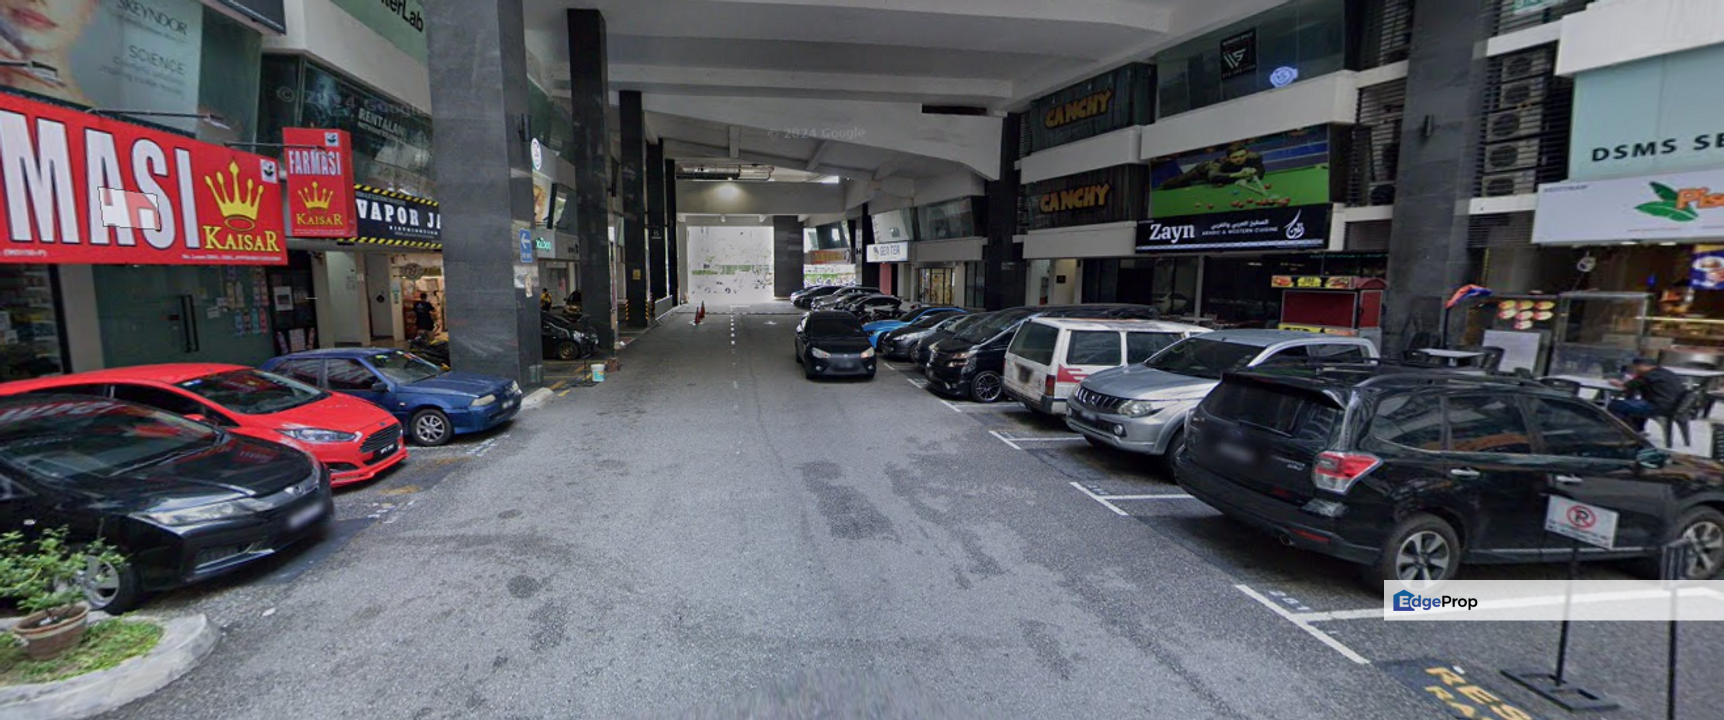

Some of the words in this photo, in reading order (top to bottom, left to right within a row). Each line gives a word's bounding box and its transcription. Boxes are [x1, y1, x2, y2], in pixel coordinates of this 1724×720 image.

[128, 44, 187, 76] SCIENCE
[1045, 88, 1113, 129] CANCHY
[288, 150, 342, 176] FARMASI
[1591, 138, 1677, 162] DSMS
[0, 109, 201, 249] MASI
[355, 198, 419, 227] VAPOR
[1040, 184, 1109, 213] CANCHY
[1149, 223, 1195, 244] Zayn
